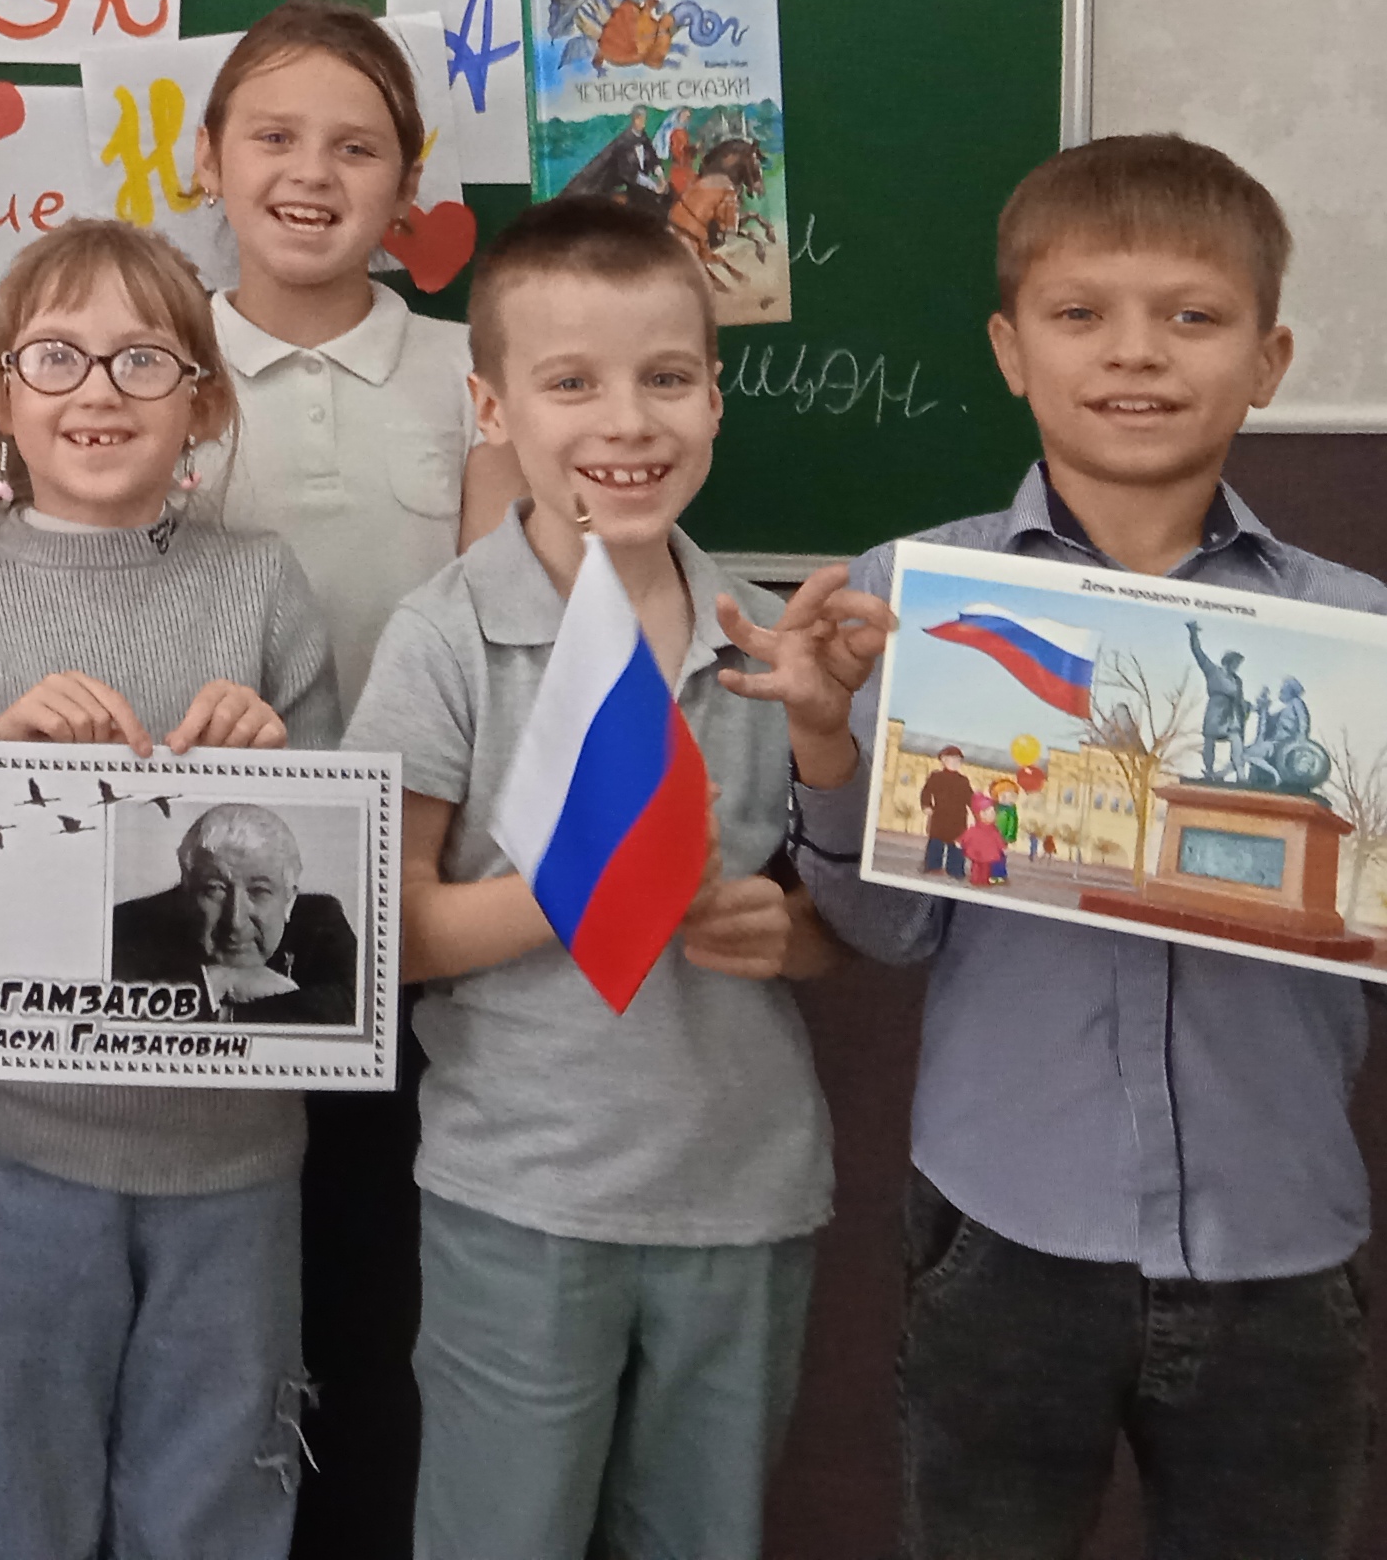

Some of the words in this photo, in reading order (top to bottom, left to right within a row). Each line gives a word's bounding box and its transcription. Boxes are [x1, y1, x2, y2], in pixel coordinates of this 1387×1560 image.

[575, 78, 672, 104] ЧЕЧЕНСКИЕ
[677, 76, 750, 99] СКАЗКИ
[1081, 578, 1115, 594] День
[1118, 586, 1190, 607] народного
[1194, 598, 1257, 617] единства
[0, 981, 200, 1017] ГАМЗАТОВ
